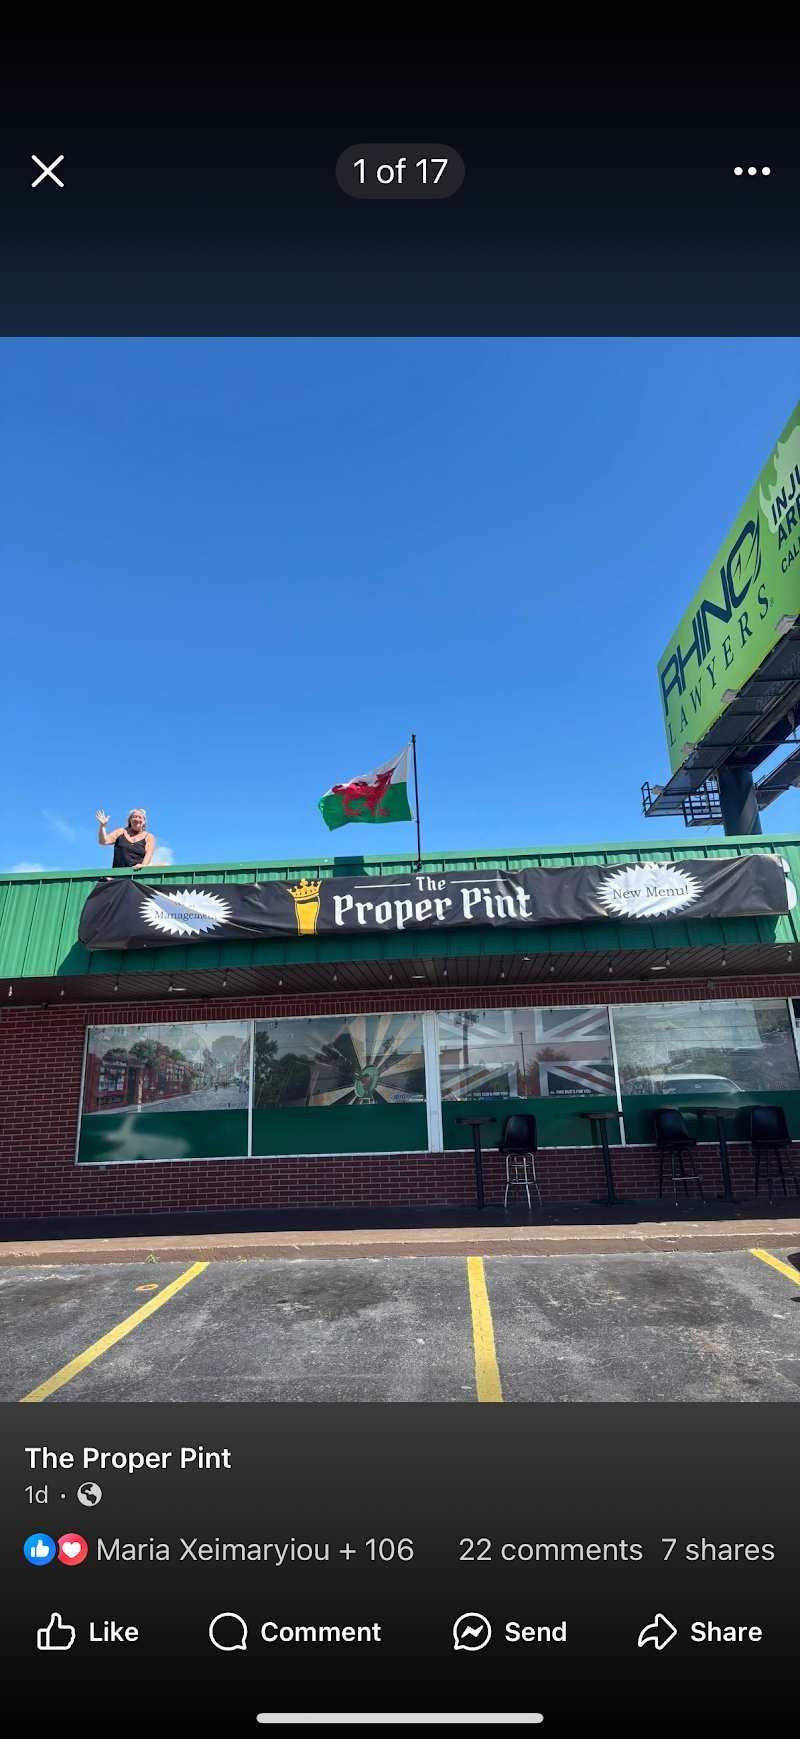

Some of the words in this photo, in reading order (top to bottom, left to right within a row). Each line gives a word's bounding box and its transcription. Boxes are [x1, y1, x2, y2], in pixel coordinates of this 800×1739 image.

[667, 583, 769, 748] LAWYERS
[415, 876, 446, 891] The
[612, 888, 642, 900] New
[646, 884, 690, 898] Menu!
[333, 893, 452, 930] Proper
[461, 886, 533, 920] Pint
